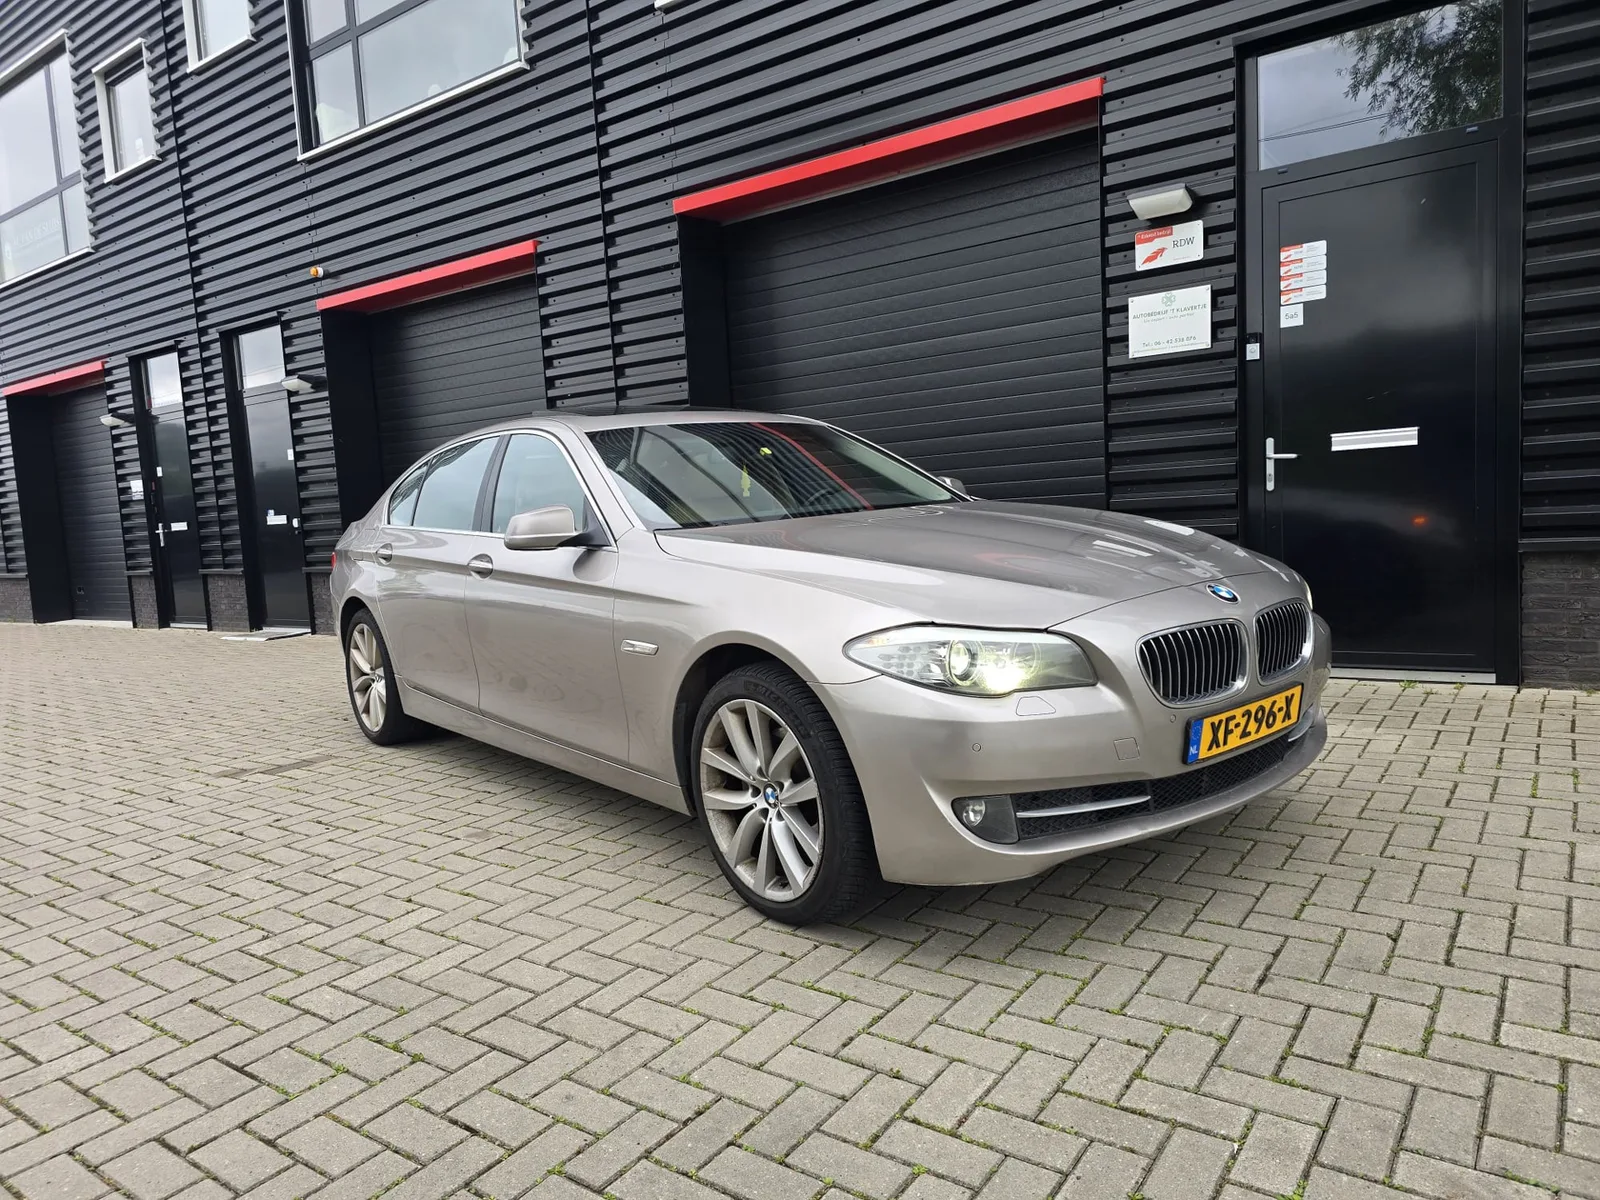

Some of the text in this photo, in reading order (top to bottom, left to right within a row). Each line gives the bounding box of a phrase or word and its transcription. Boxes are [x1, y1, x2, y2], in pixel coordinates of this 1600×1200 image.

[1172, 236, 1195, 248] RDW
[1132, 309, 1168, 319] AUTOBEDRIJF
[1176, 303, 1207, 313] KLAVERTJE
[1284, 312, 1299, 320] 5a5
[1207, 693, 1295, 752] XF-296-X
[1189, 745, 1198, 755] NL
